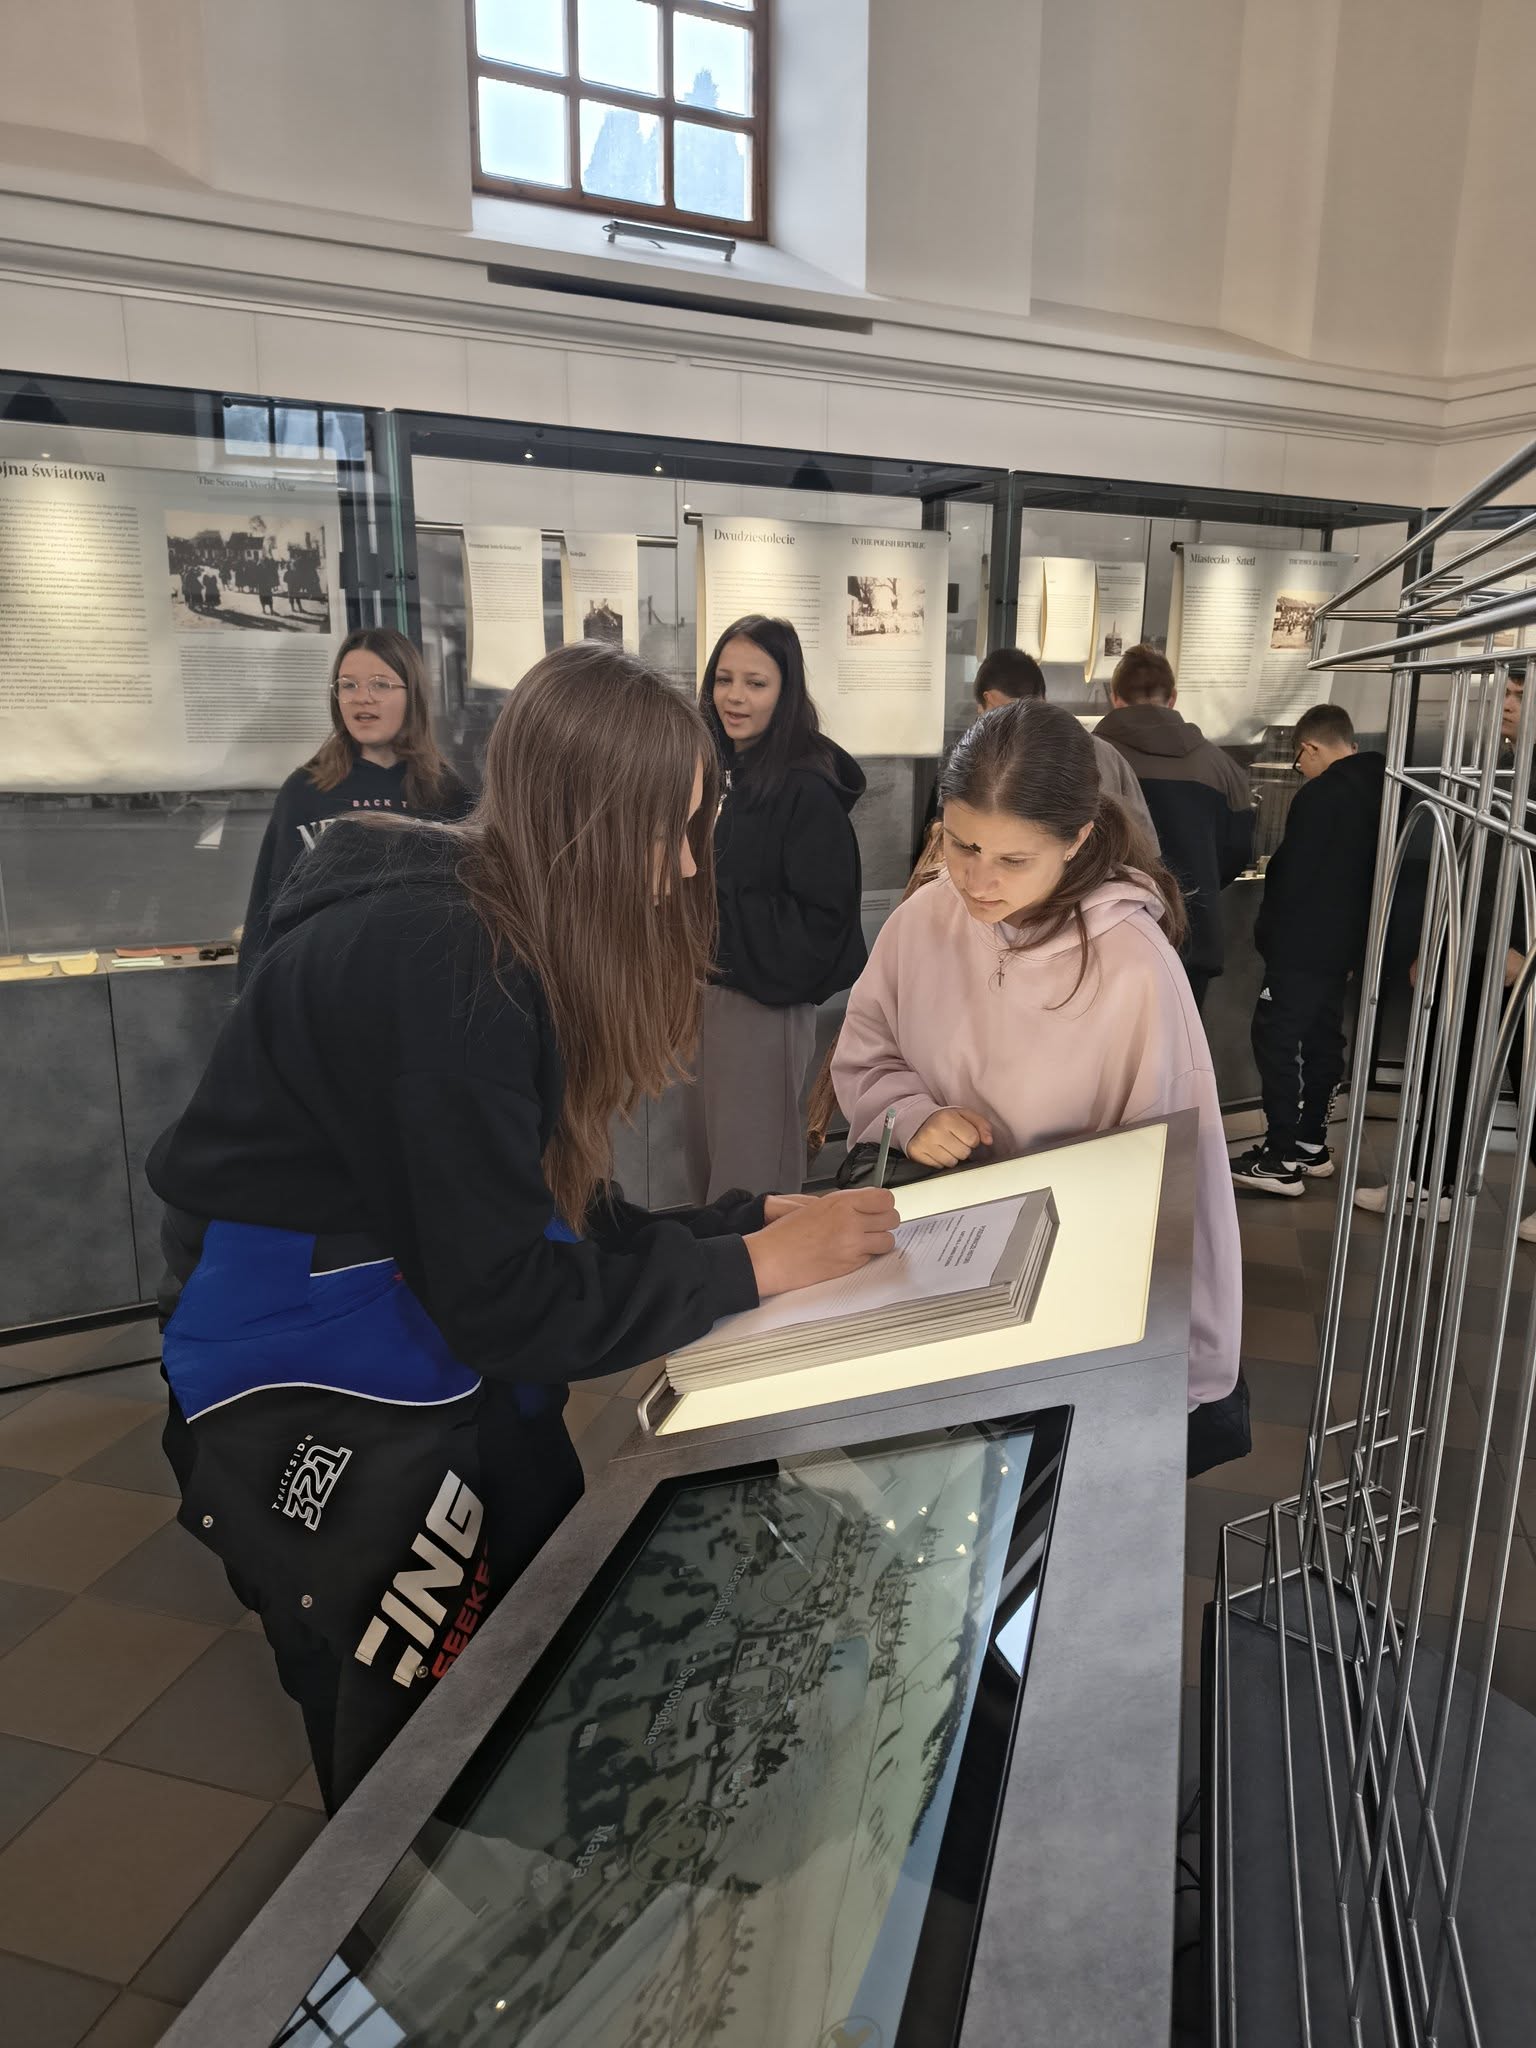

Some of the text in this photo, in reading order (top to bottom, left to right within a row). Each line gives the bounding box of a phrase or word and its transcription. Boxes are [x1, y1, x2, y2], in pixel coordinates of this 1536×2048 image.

[32, 463, 106, 482] światowa
[713, 528, 796, 546] Dwudziestolecie
[860, 538, 873, 546] THE
[1189, 552, 1230, 565] Miasteczko
[352, 799, 392, 808] BACK
[282, 1446, 353, 1531] 321
[706, 1552, 755, 1628] Przewodnik
[643, 1666, 697, 1747] Swobodne
[572, 1823, 617, 1881] Mapa
